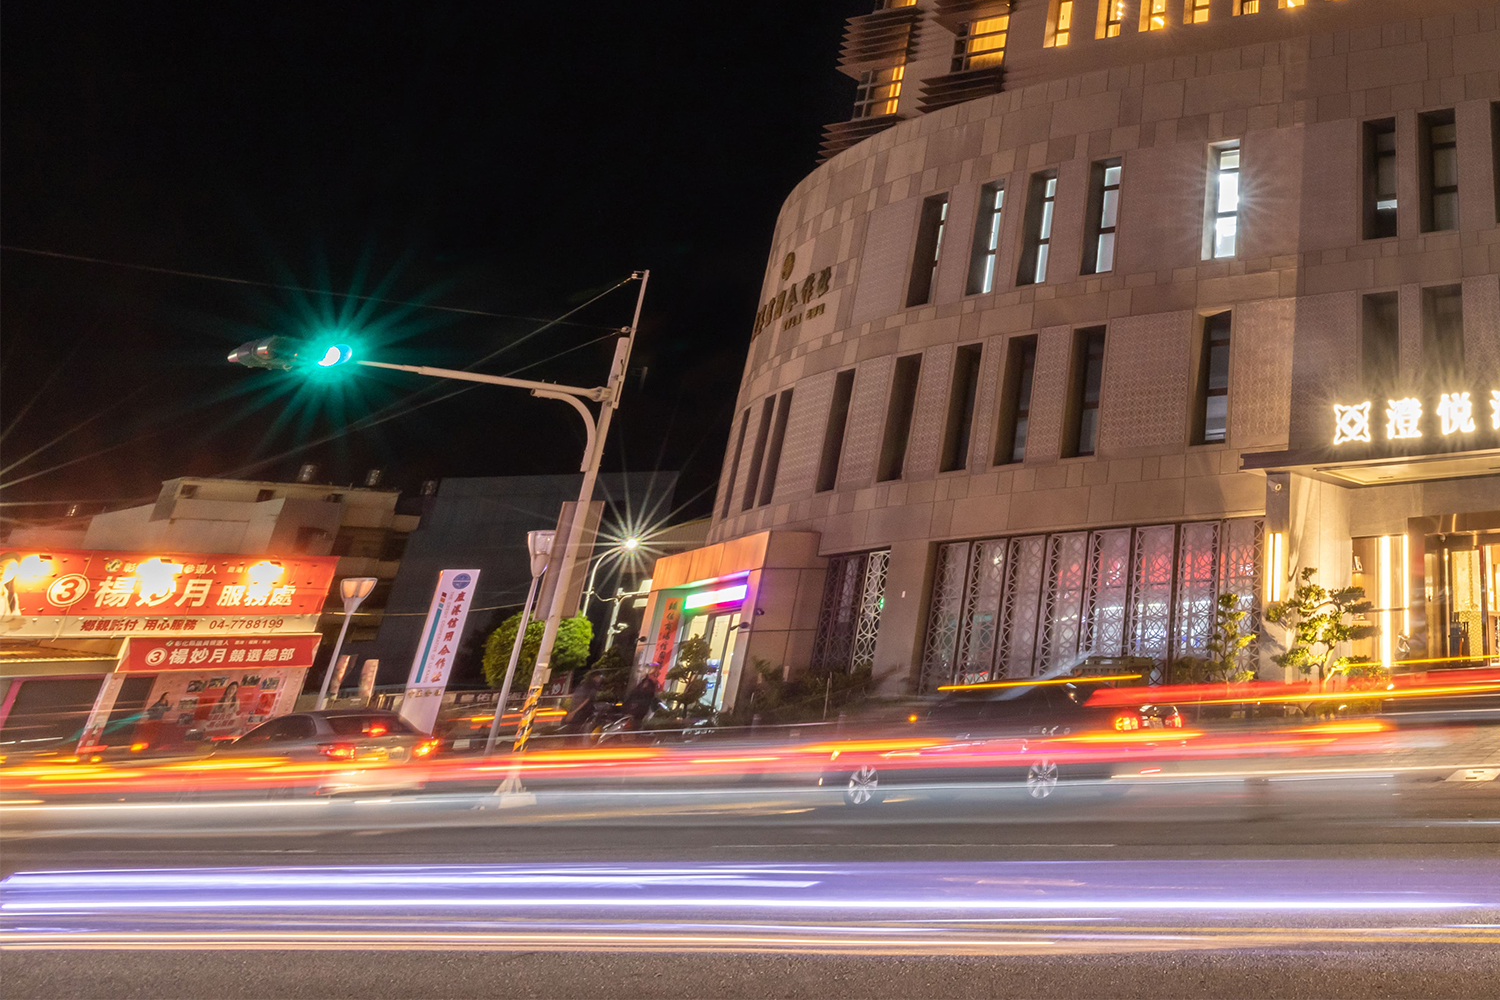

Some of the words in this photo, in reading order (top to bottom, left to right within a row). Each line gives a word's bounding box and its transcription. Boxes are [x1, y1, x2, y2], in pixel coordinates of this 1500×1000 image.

[142, 618, 199, 631] 用心服務
[208, 619, 284, 630] 04-7788199
[430, 591, 467, 684] 鹿港信用合作社
[168, 648, 228, 665] 楊妙月
[228, 648, 296, 663] 競選總部
